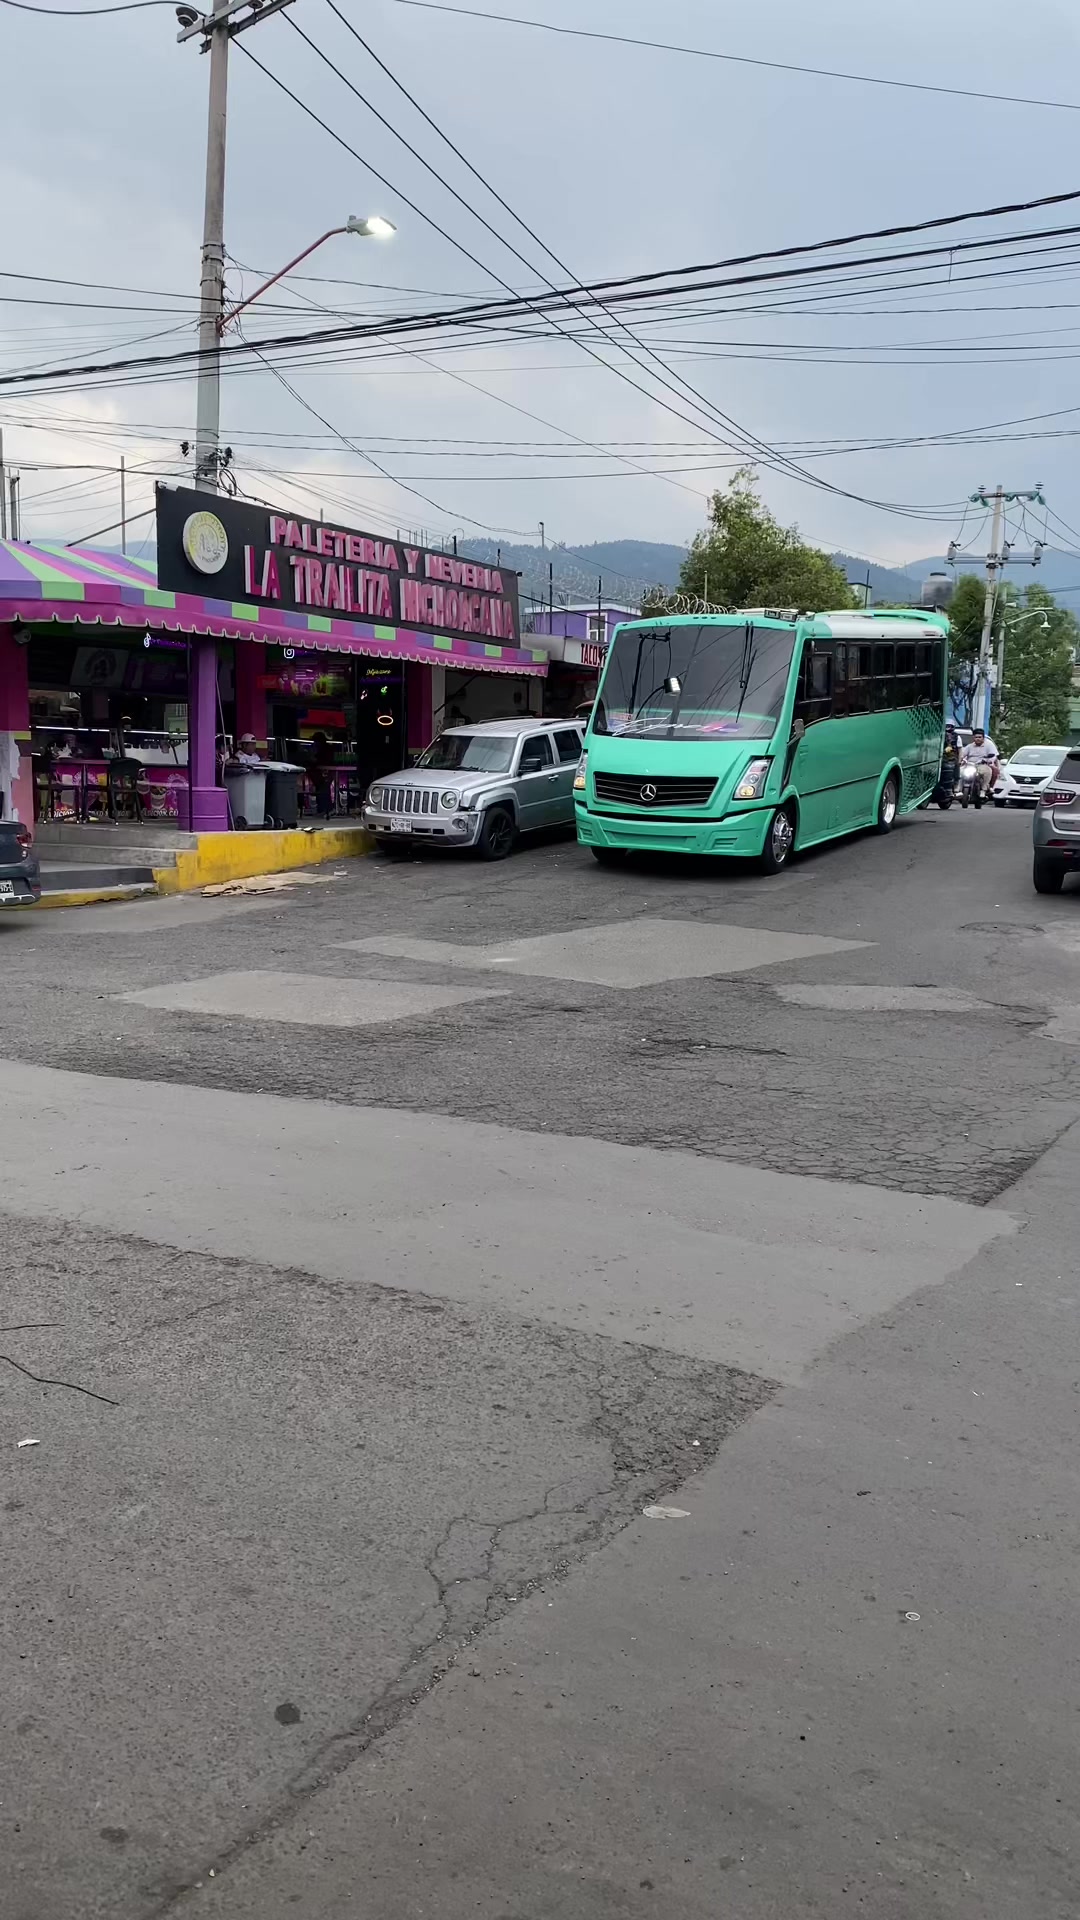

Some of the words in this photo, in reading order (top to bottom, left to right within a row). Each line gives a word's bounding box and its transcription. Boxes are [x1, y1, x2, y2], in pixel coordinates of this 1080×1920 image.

[244, 544, 282, 600] LA
[289, 555, 393, 618] TRAILITA
[400, 578, 516, 640] MICHOACANA
[269, 515, 400, 570] PALETERIA
[403, 549, 419, 574] Y
[425, 553, 504, 593] NEVERIA
